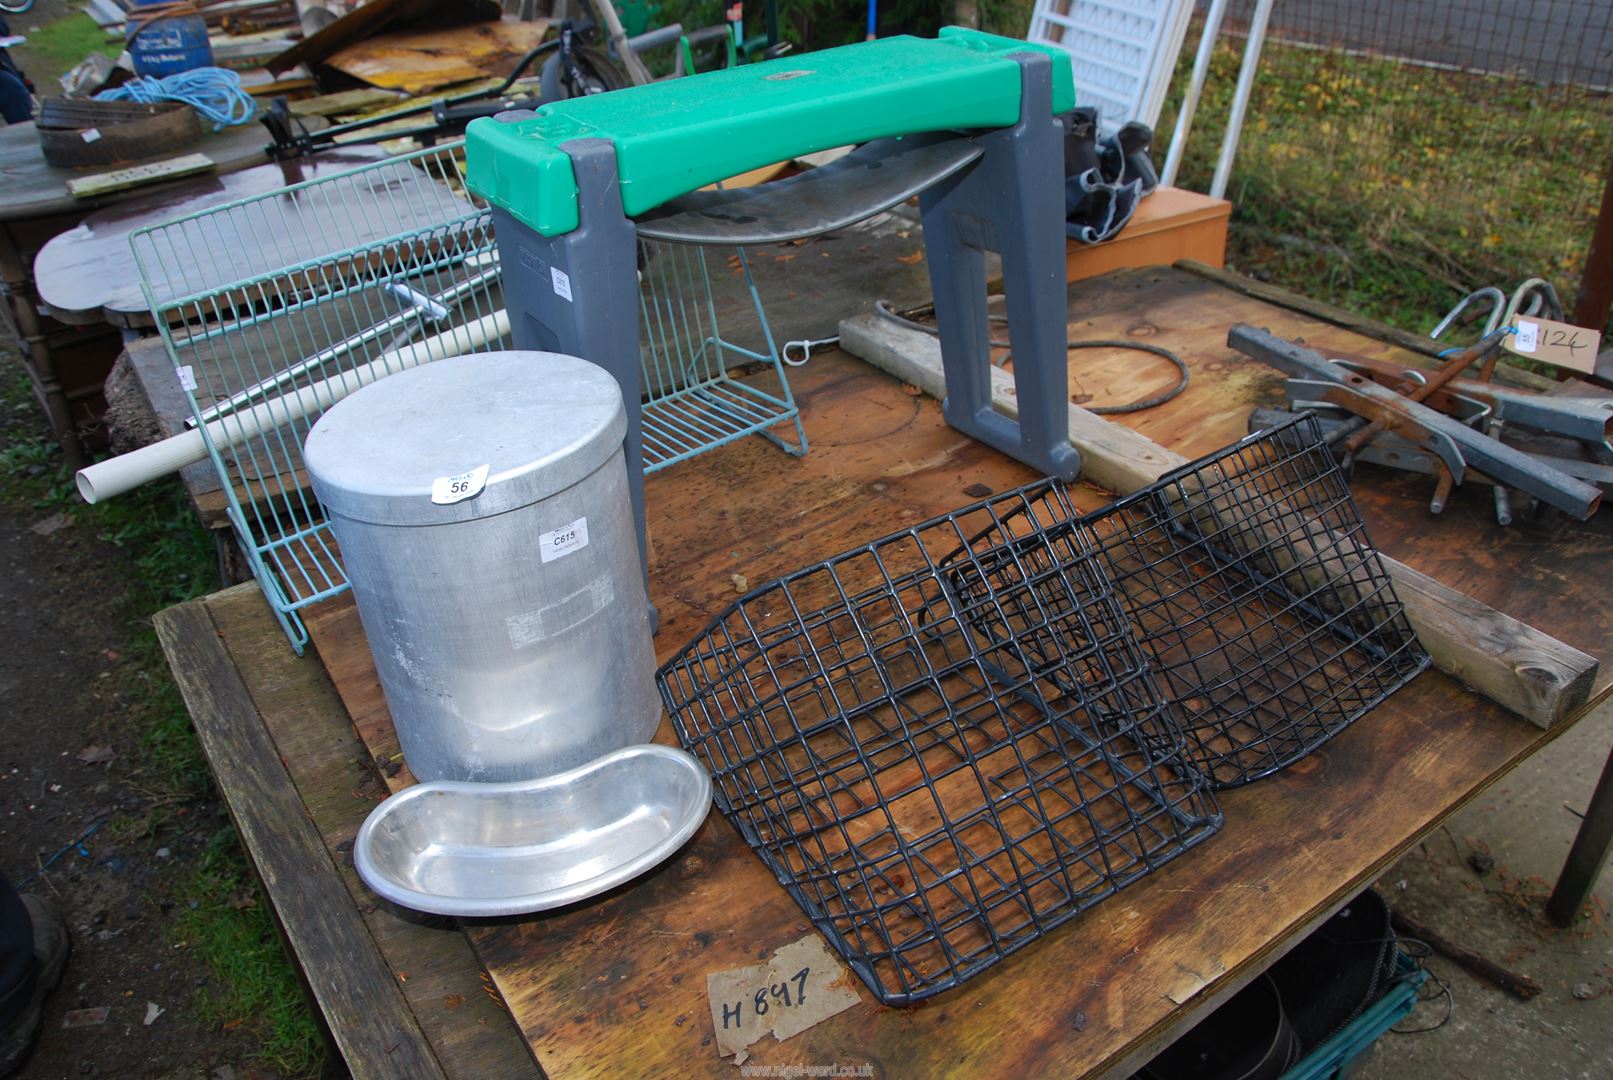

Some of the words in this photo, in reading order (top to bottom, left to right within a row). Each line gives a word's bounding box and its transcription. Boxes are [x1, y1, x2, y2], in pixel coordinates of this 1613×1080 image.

[1541, 328, 1587, 357] 124
[451, 481, 469, 493] 56
[553, 530, 576, 546] C615
[722, 1001, 742, 1029] H
[754, 967, 810, 1016] 897
